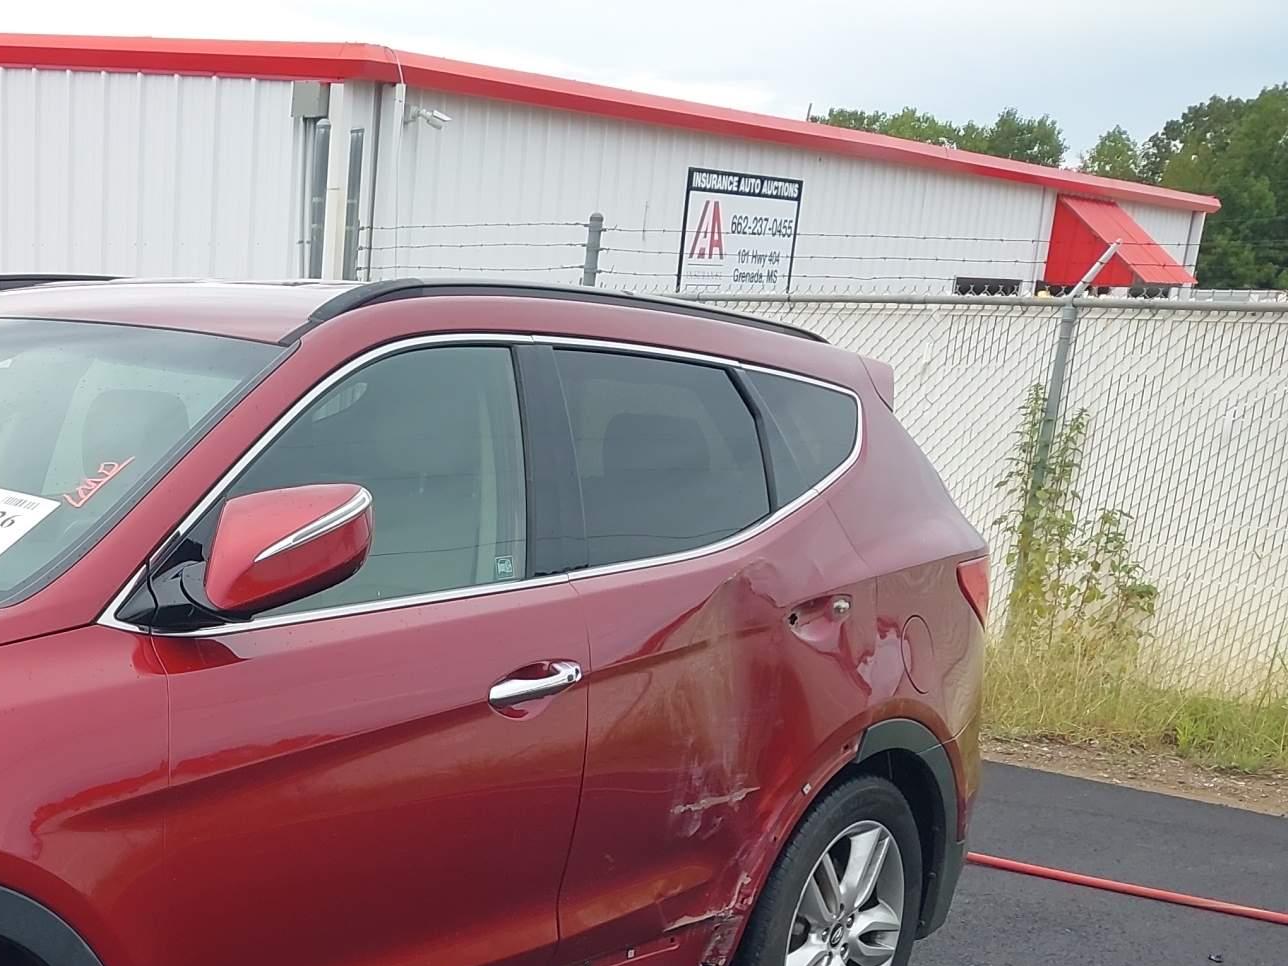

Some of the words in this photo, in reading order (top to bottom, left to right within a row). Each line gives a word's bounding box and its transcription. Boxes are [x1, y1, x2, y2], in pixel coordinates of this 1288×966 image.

[692, 172, 738, 191] INSURANCE
[739, 177, 761, 193] AUTO
[761, 180, 800, 198] AUCTIONS
[731, 215, 793, 238] 662-237-0455
